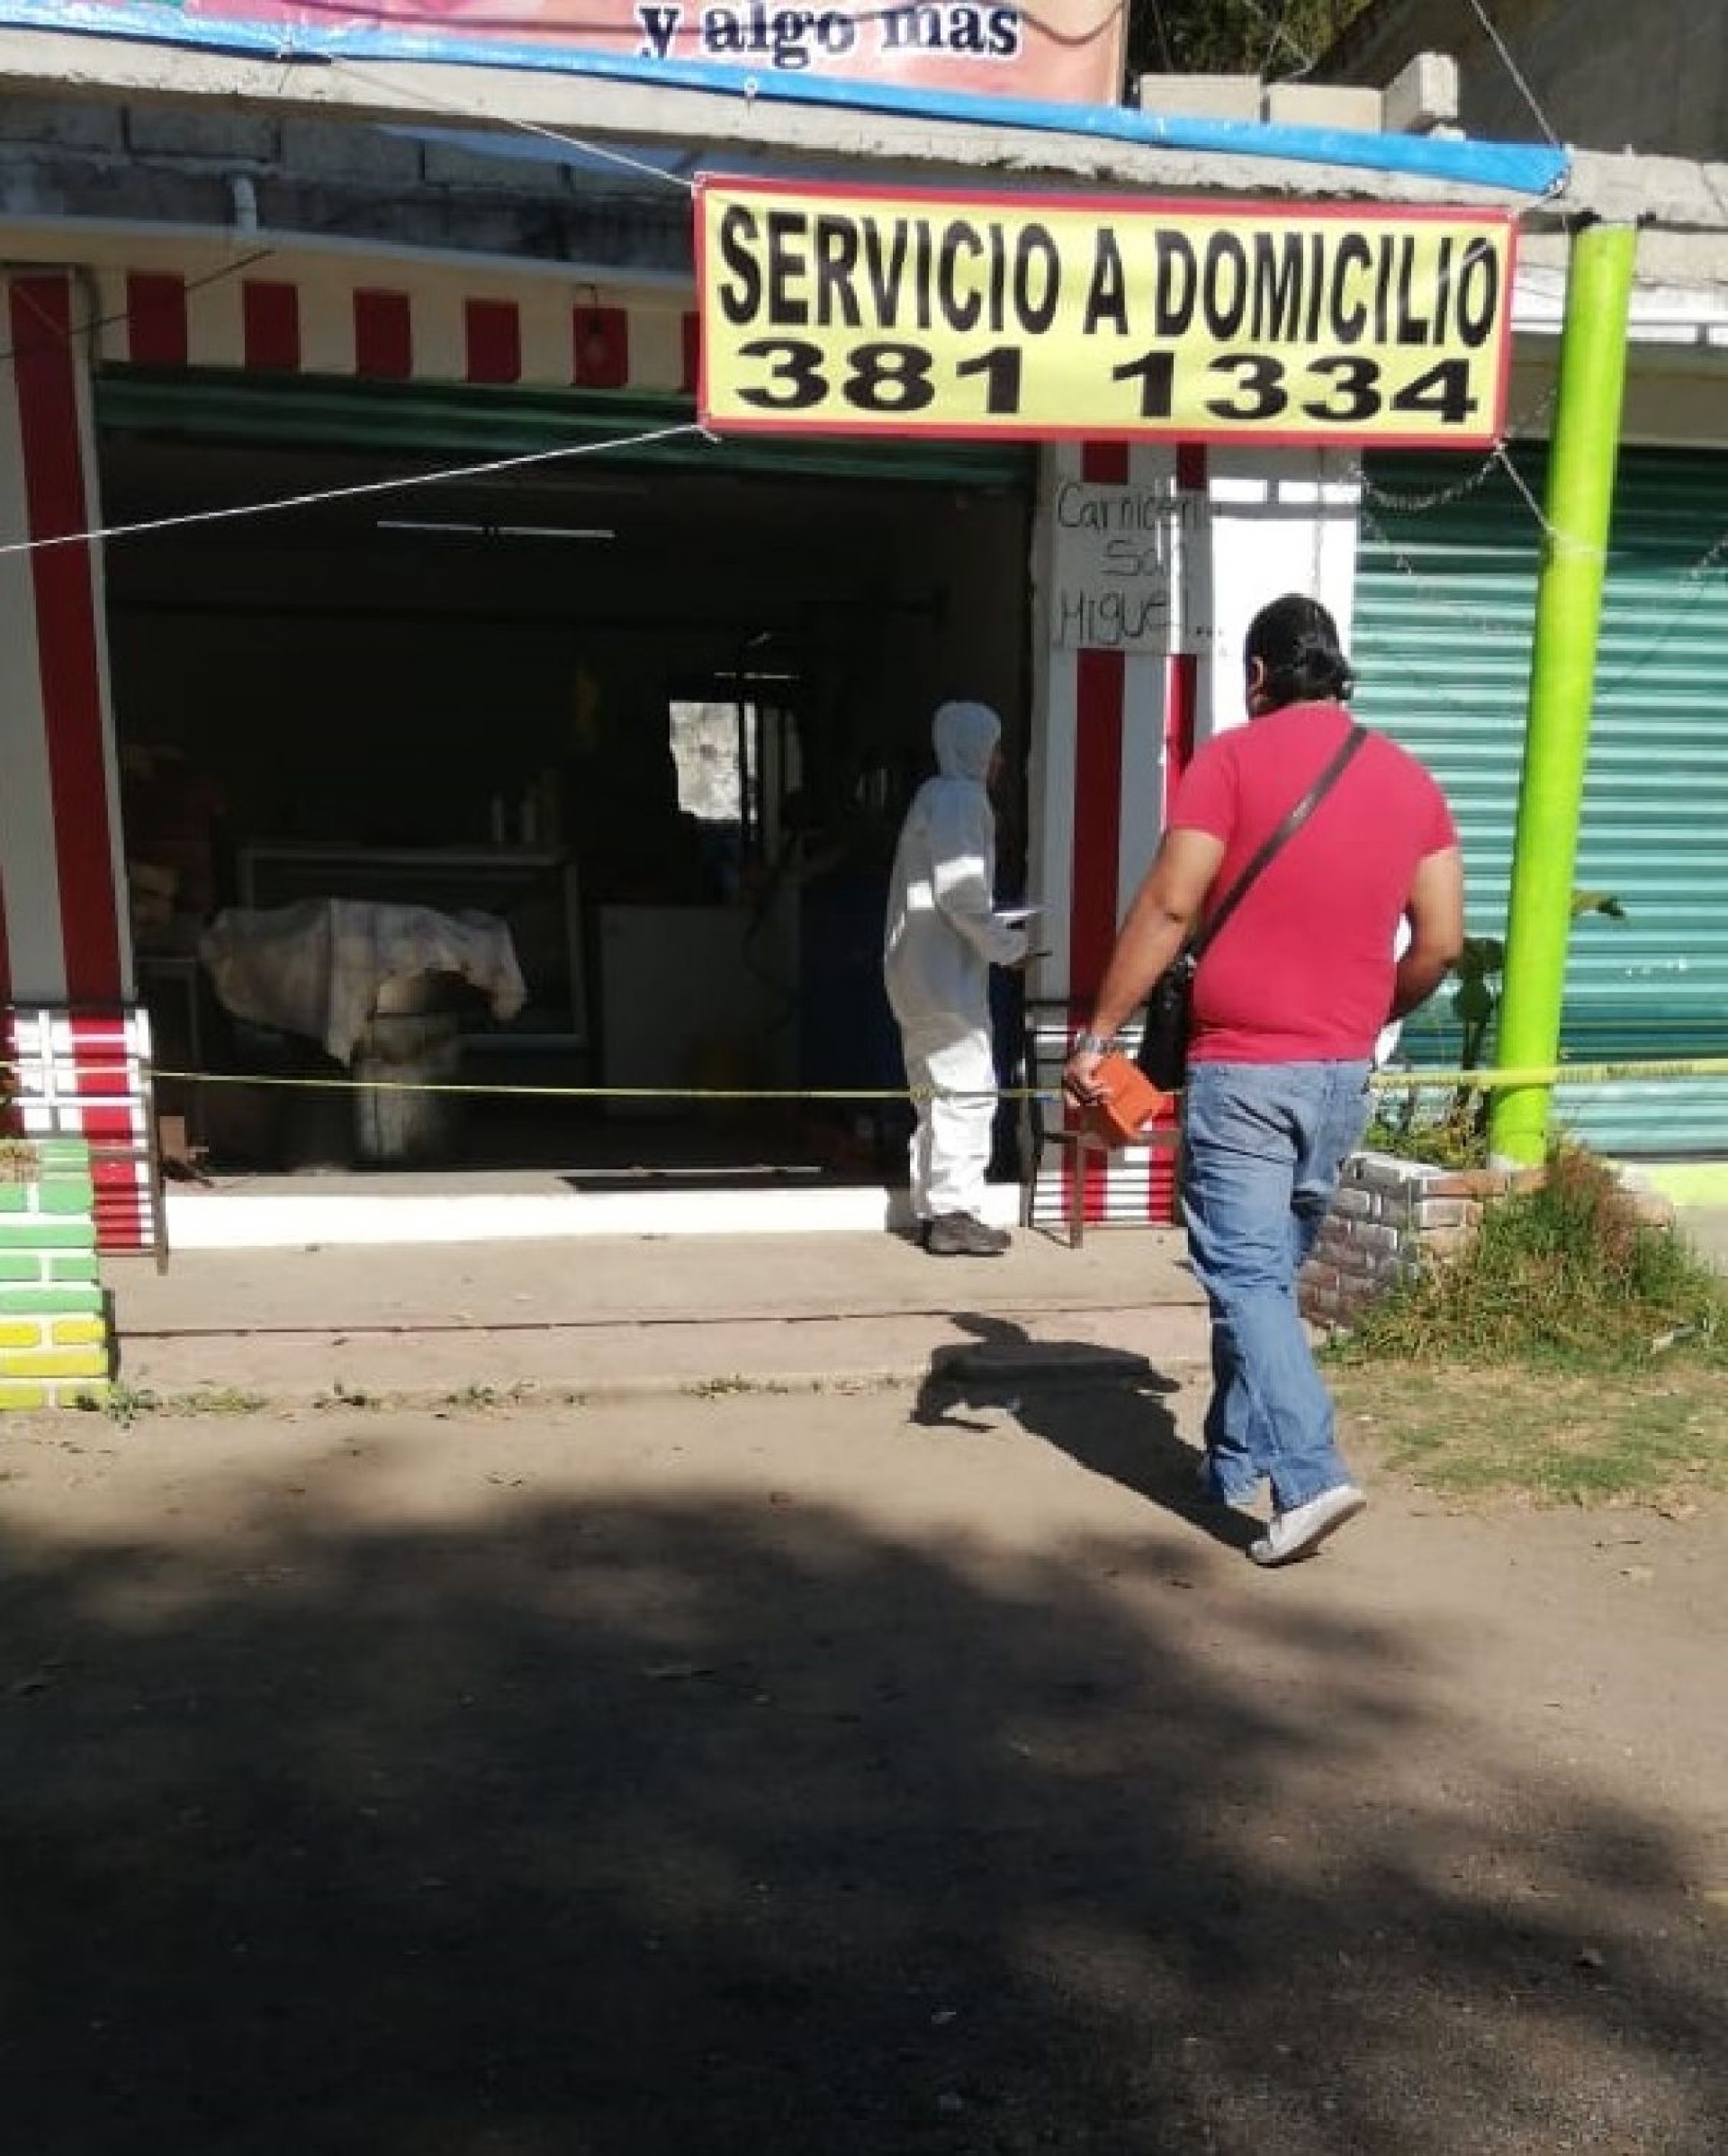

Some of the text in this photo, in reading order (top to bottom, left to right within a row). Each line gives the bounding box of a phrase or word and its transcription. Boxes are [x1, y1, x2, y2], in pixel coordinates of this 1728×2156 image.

[640, 7, 680, 59] y
[706, 0, 855, 69] algo
[719, 203, 1498, 347] SERVICIO A DOMICILIO
[735, 338, 1479, 424] 381 1334
